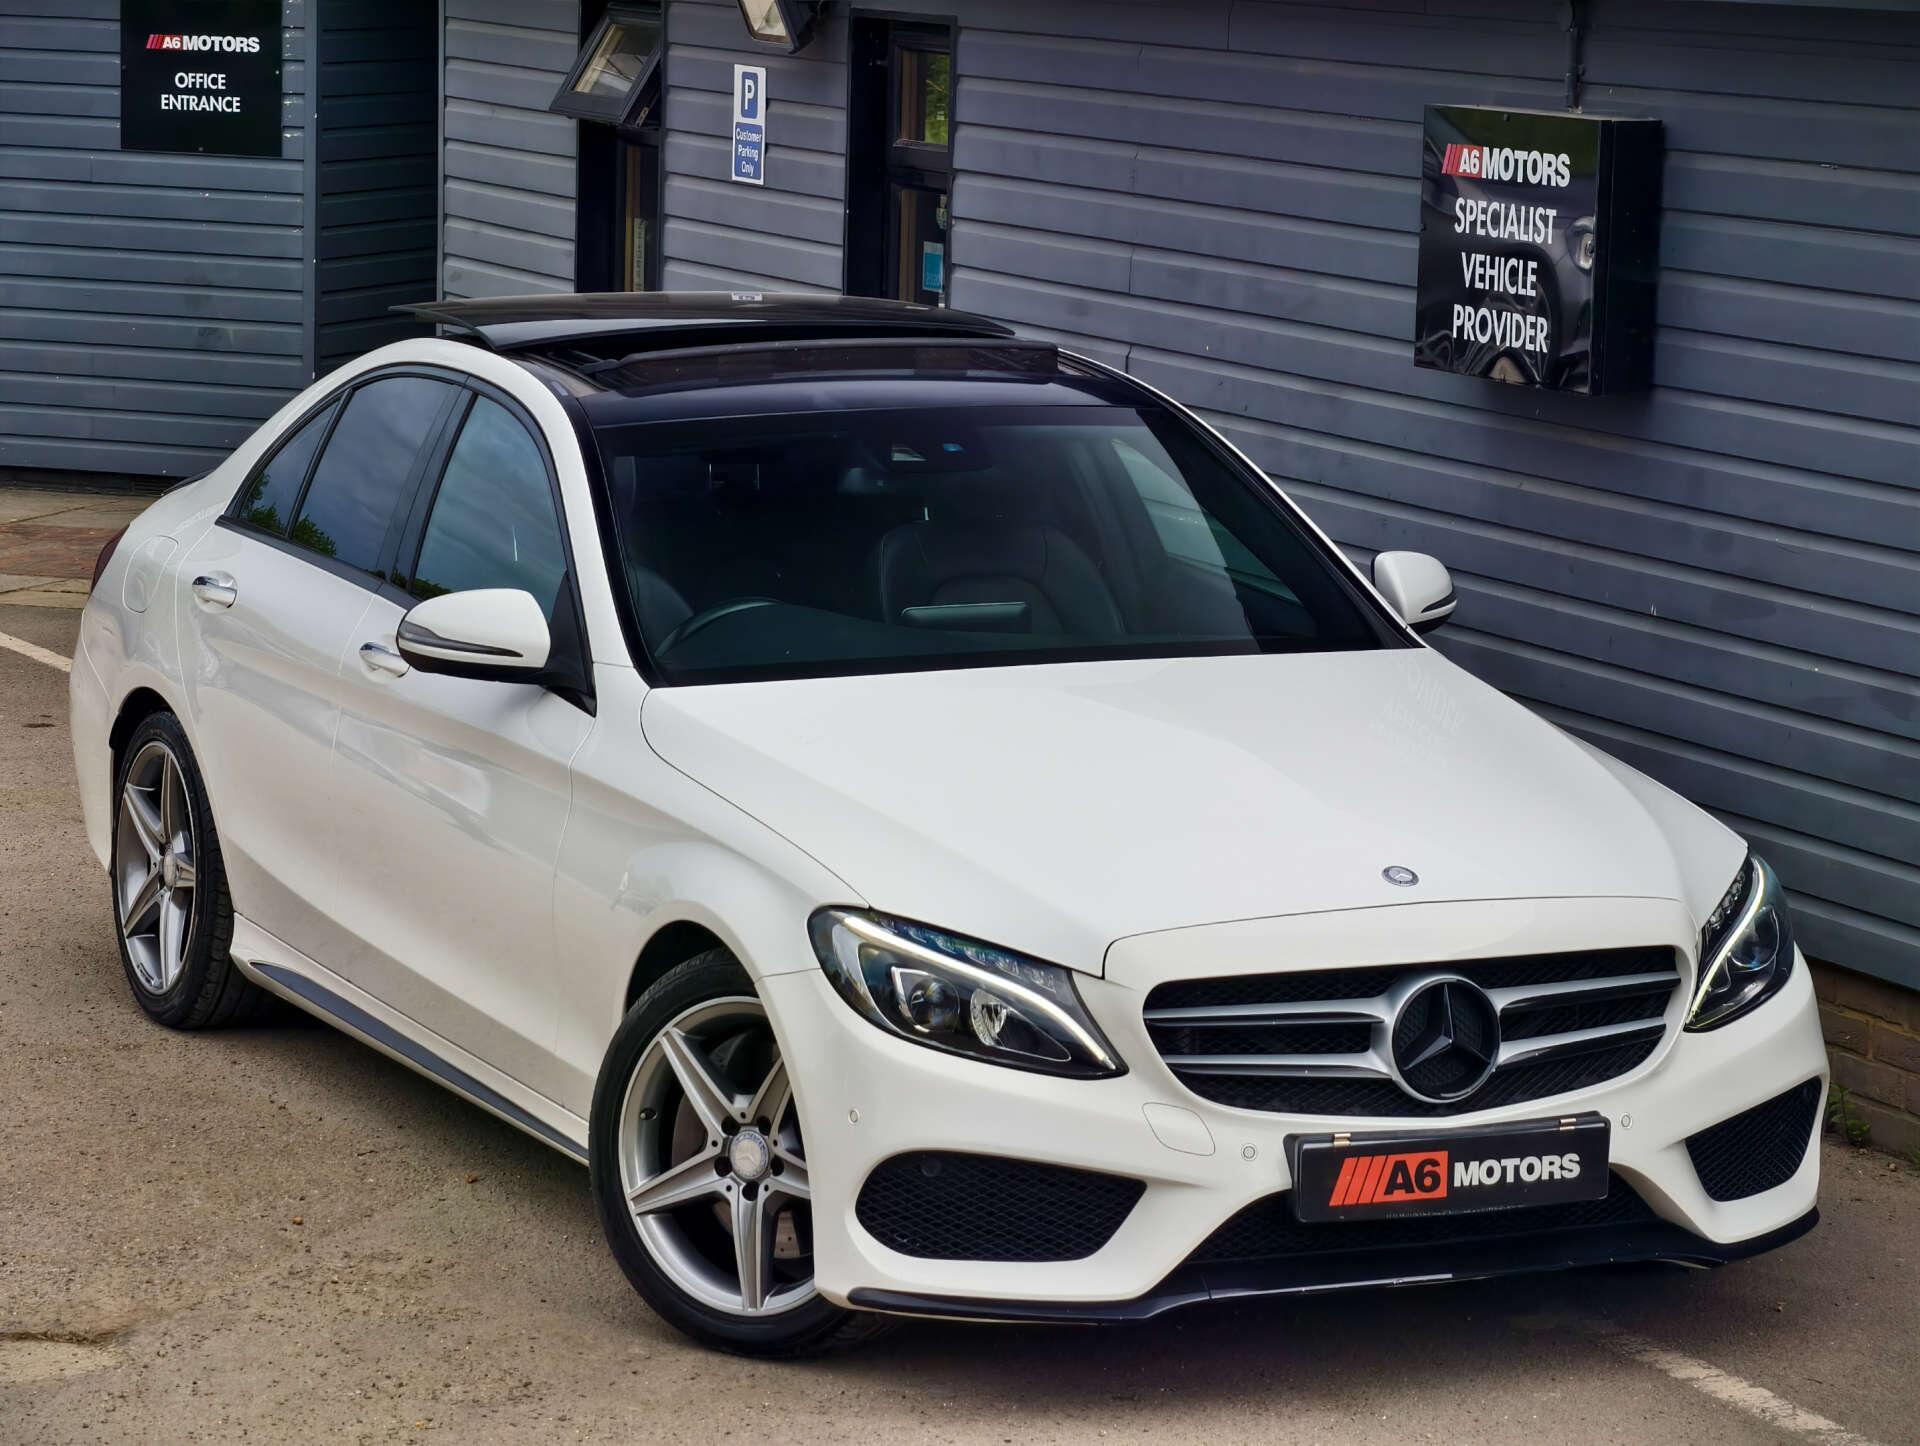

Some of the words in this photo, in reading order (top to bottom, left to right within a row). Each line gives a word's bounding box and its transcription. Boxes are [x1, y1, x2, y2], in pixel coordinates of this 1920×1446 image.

[162, 36, 181, 49] A6
[182, 35, 260, 52] MOTORS
[174, 72, 227, 89] OFFICE
[160, 94, 241, 112] ENTRANCE
[744, 79, 755, 110] P
[735, 128, 762, 142] Customer
[738, 145, 759, 161] Parking
[741, 161, 755, 176] Only
[1458, 148, 1480, 175] A6
[1481, 146, 1571, 188] MOTORS
[1454, 197, 1557, 245] SPECIALIST
[1461, 251, 1538, 297] VEHICLE
[1452, 303, 1549, 353] PROVIDER
[1384, 1157, 1442, 1195] A6
[1453, 1153, 1581, 1187] MOTORS
